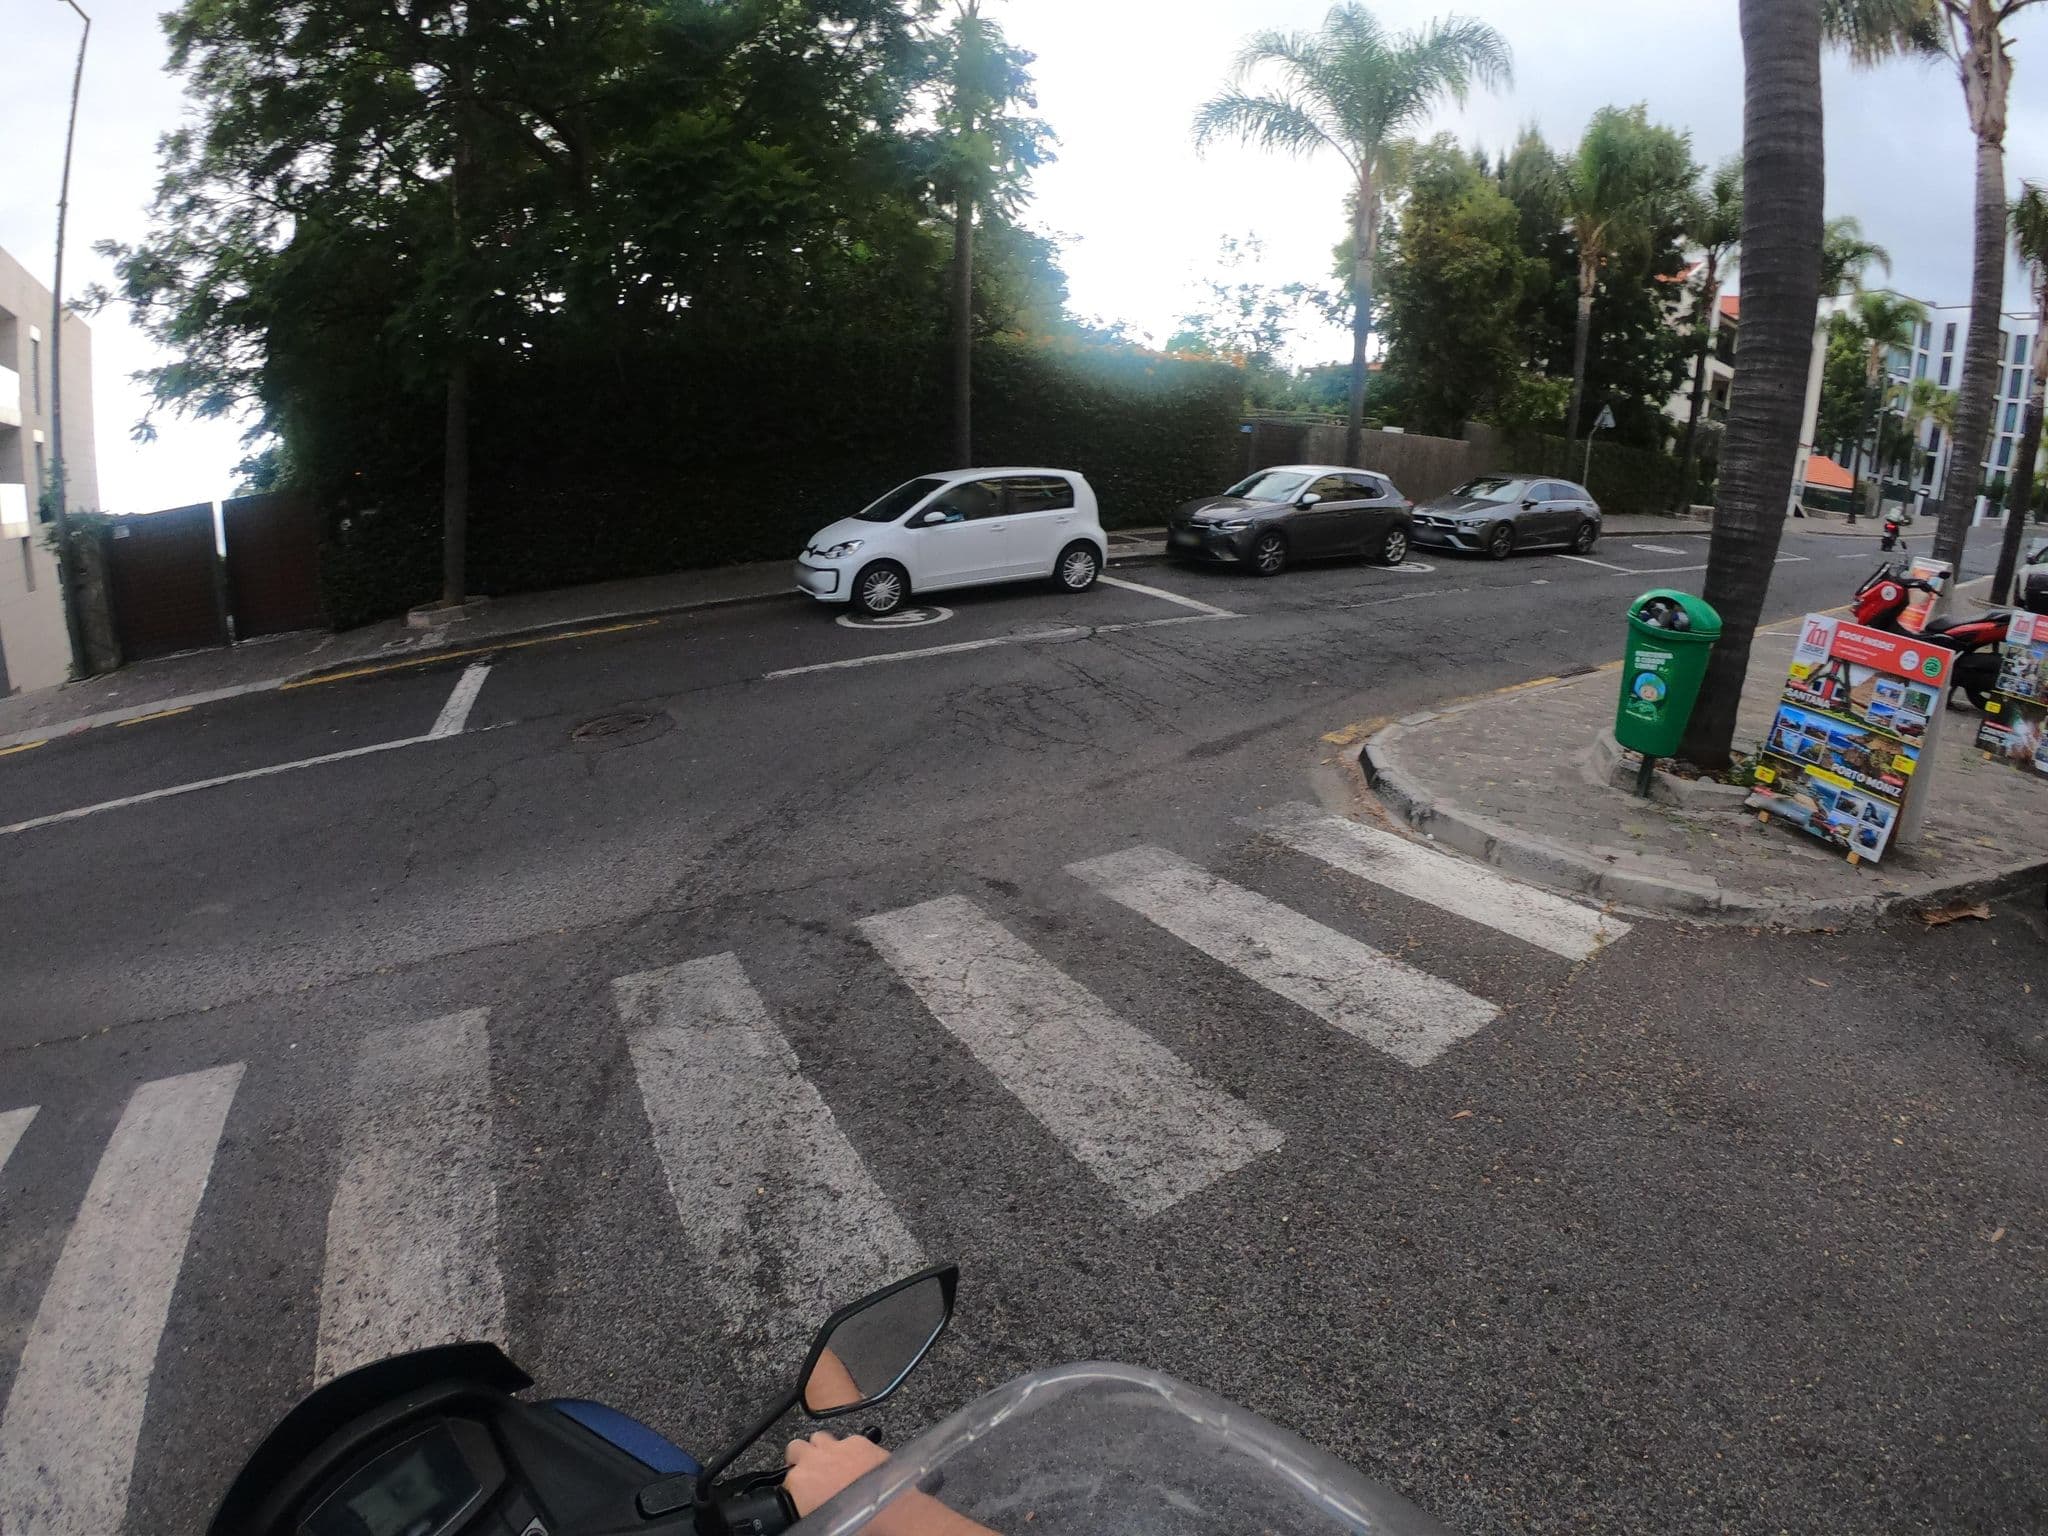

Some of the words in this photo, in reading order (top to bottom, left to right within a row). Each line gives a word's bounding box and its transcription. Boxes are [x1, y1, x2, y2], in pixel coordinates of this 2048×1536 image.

[1784, 688, 1831, 709] SANTANA
[1830, 762, 1865, 784] PORTO
[1864, 775, 1904, 798] MONIZ
